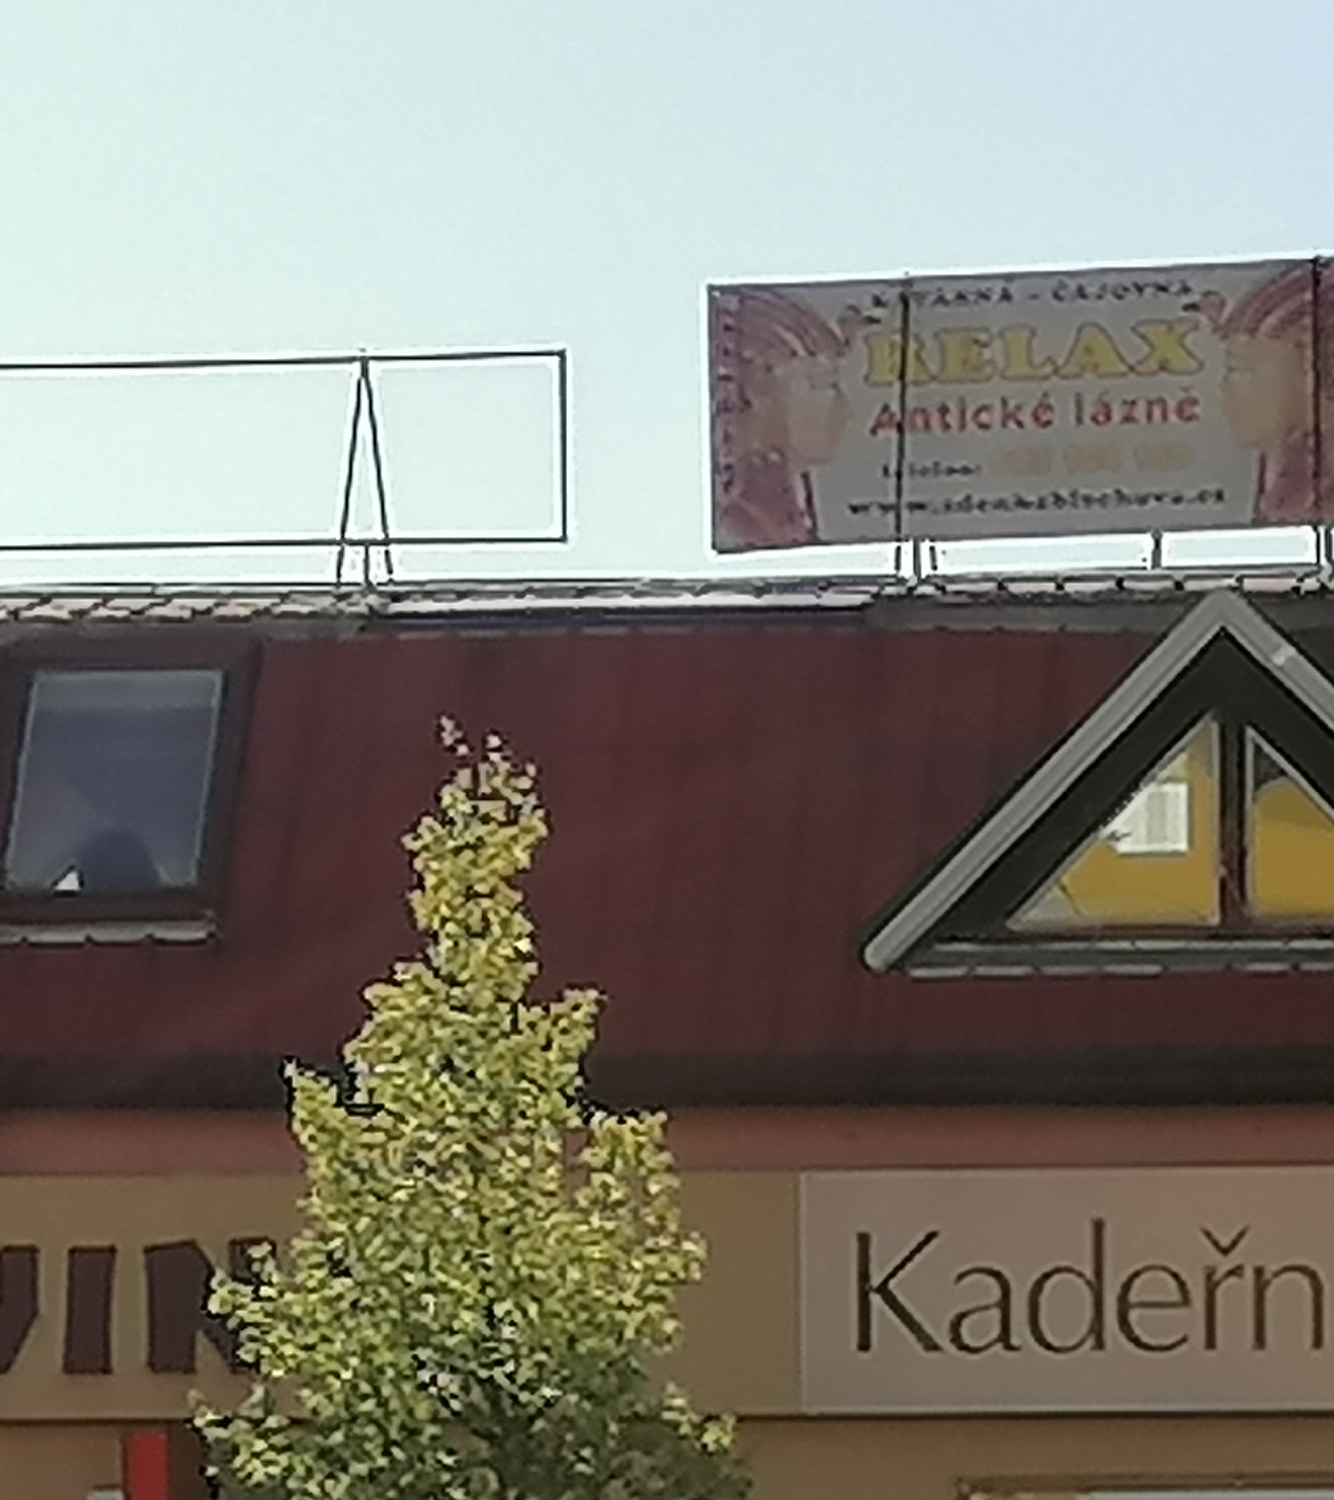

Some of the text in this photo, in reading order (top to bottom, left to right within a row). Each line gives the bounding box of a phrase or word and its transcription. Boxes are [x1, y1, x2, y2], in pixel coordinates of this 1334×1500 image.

[866, 321, 1206, 386] RELAX
[869, 391, 1201, 437] Antické lázně
